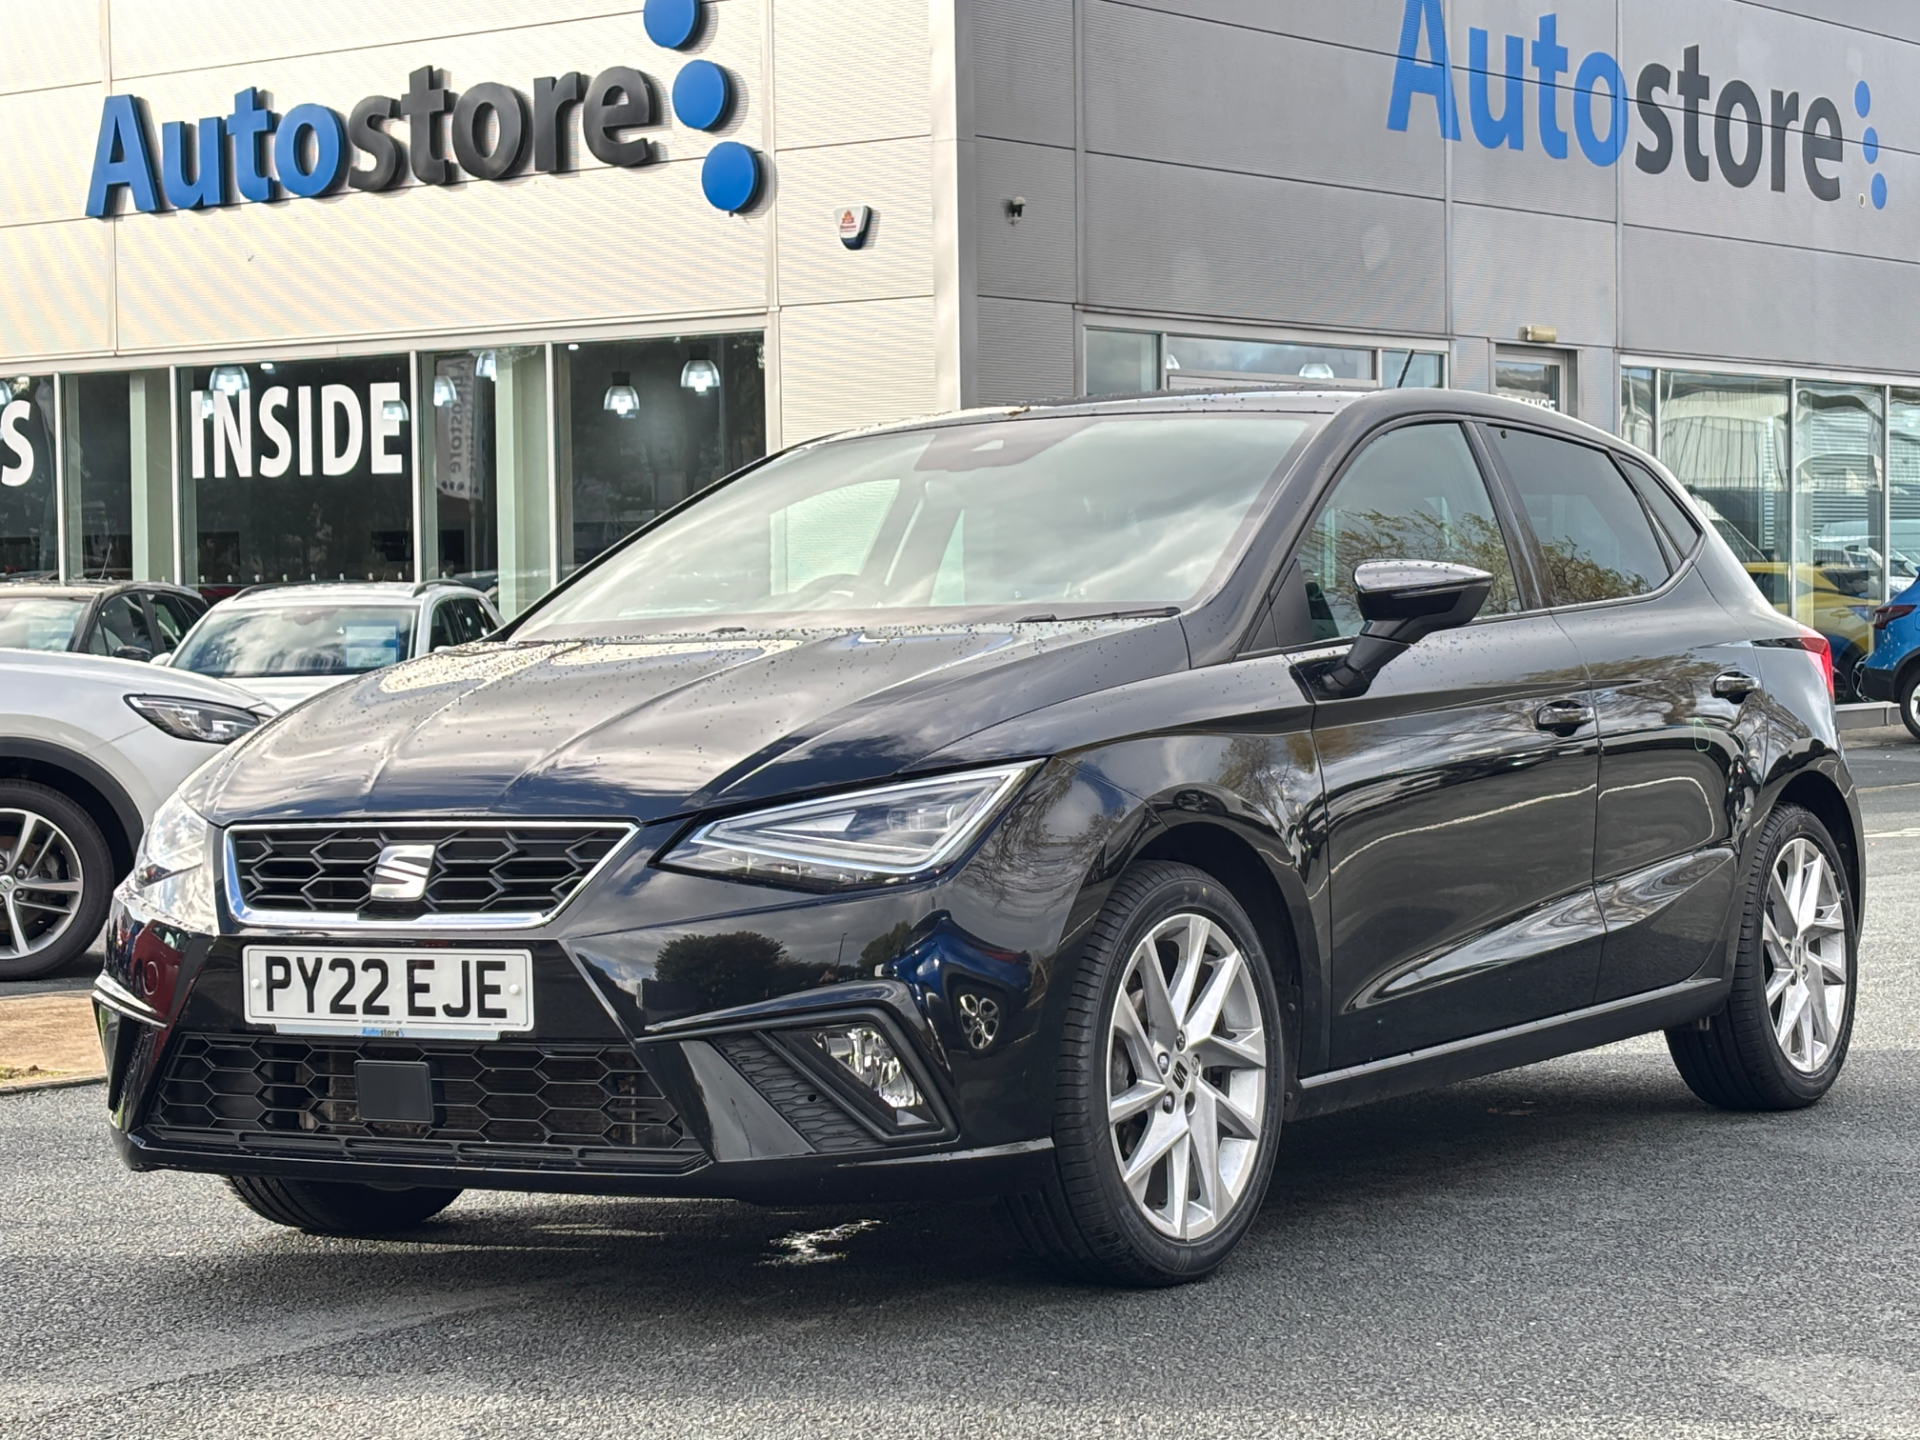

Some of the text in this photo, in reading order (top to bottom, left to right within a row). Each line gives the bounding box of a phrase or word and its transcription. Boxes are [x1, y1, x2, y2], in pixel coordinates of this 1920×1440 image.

[85, 64, 660, 219] Autostore
[1386, 0, 1843, 202] Autostore
[190, 382, 403, 480] INSIDE
[265, 955, 508, 1019] PY22 EJE
[361, 1026, 401, 1038] Autostore
